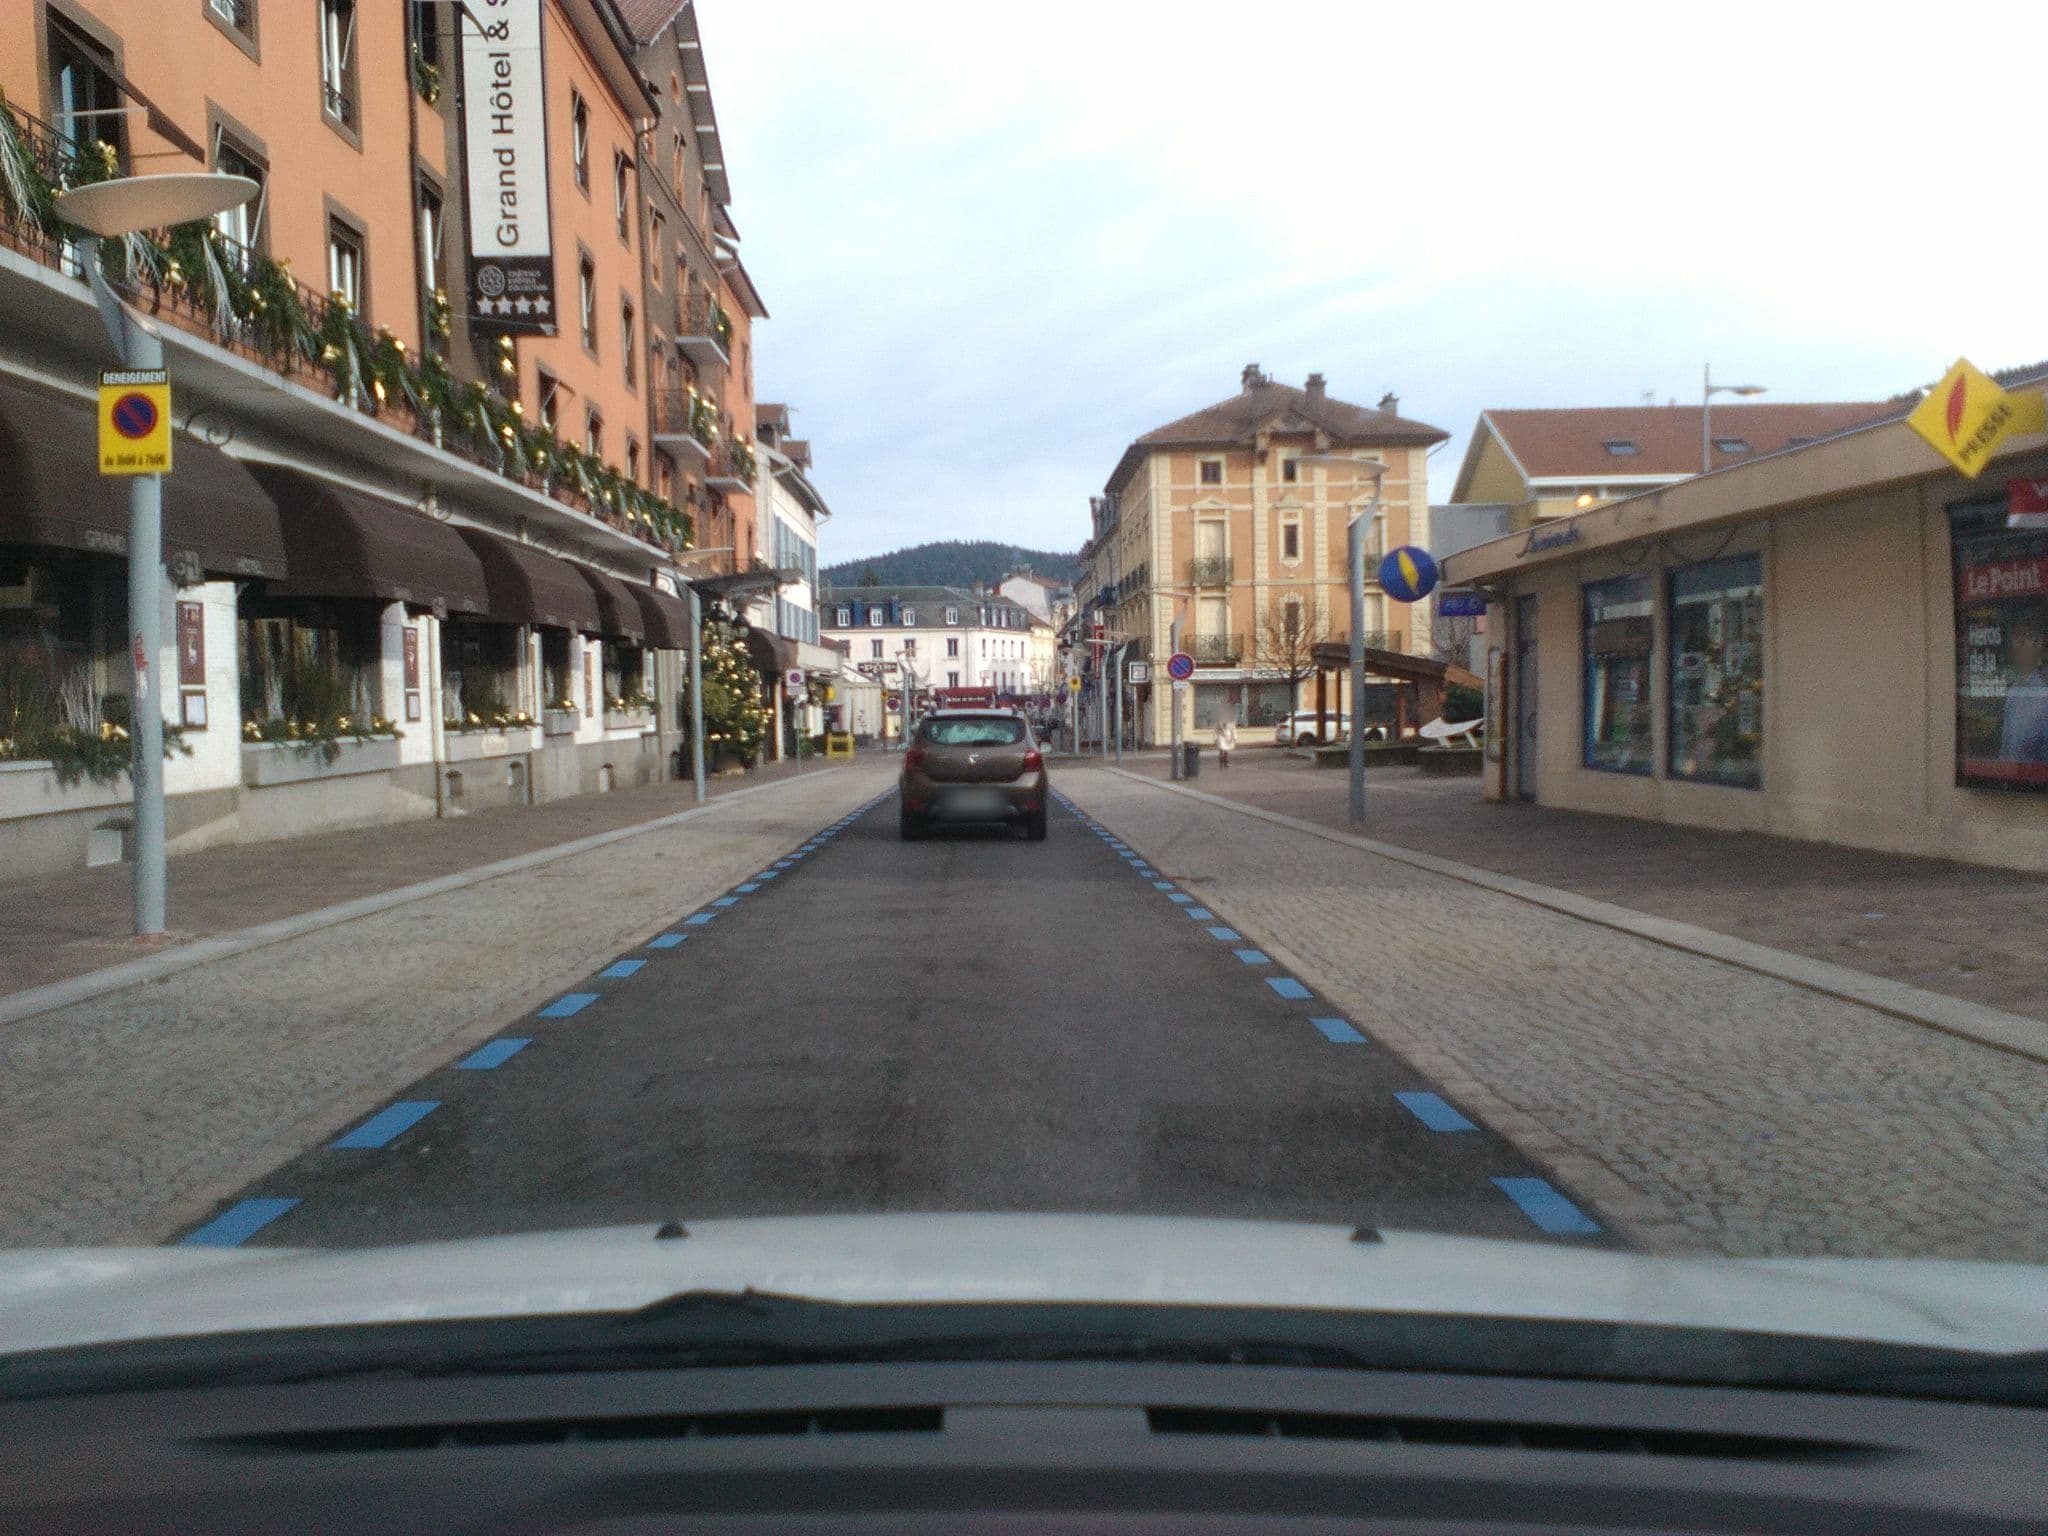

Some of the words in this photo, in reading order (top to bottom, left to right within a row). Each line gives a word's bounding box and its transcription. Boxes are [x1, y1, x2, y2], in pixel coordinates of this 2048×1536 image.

[486, 19, 509, 41] &
[488, 51, 514, 135] Hôtel
[492, 148, 519, 247] Grand
[1968, 570, 1990, 596] Le
[1991, 563, 2041, 594] Point
